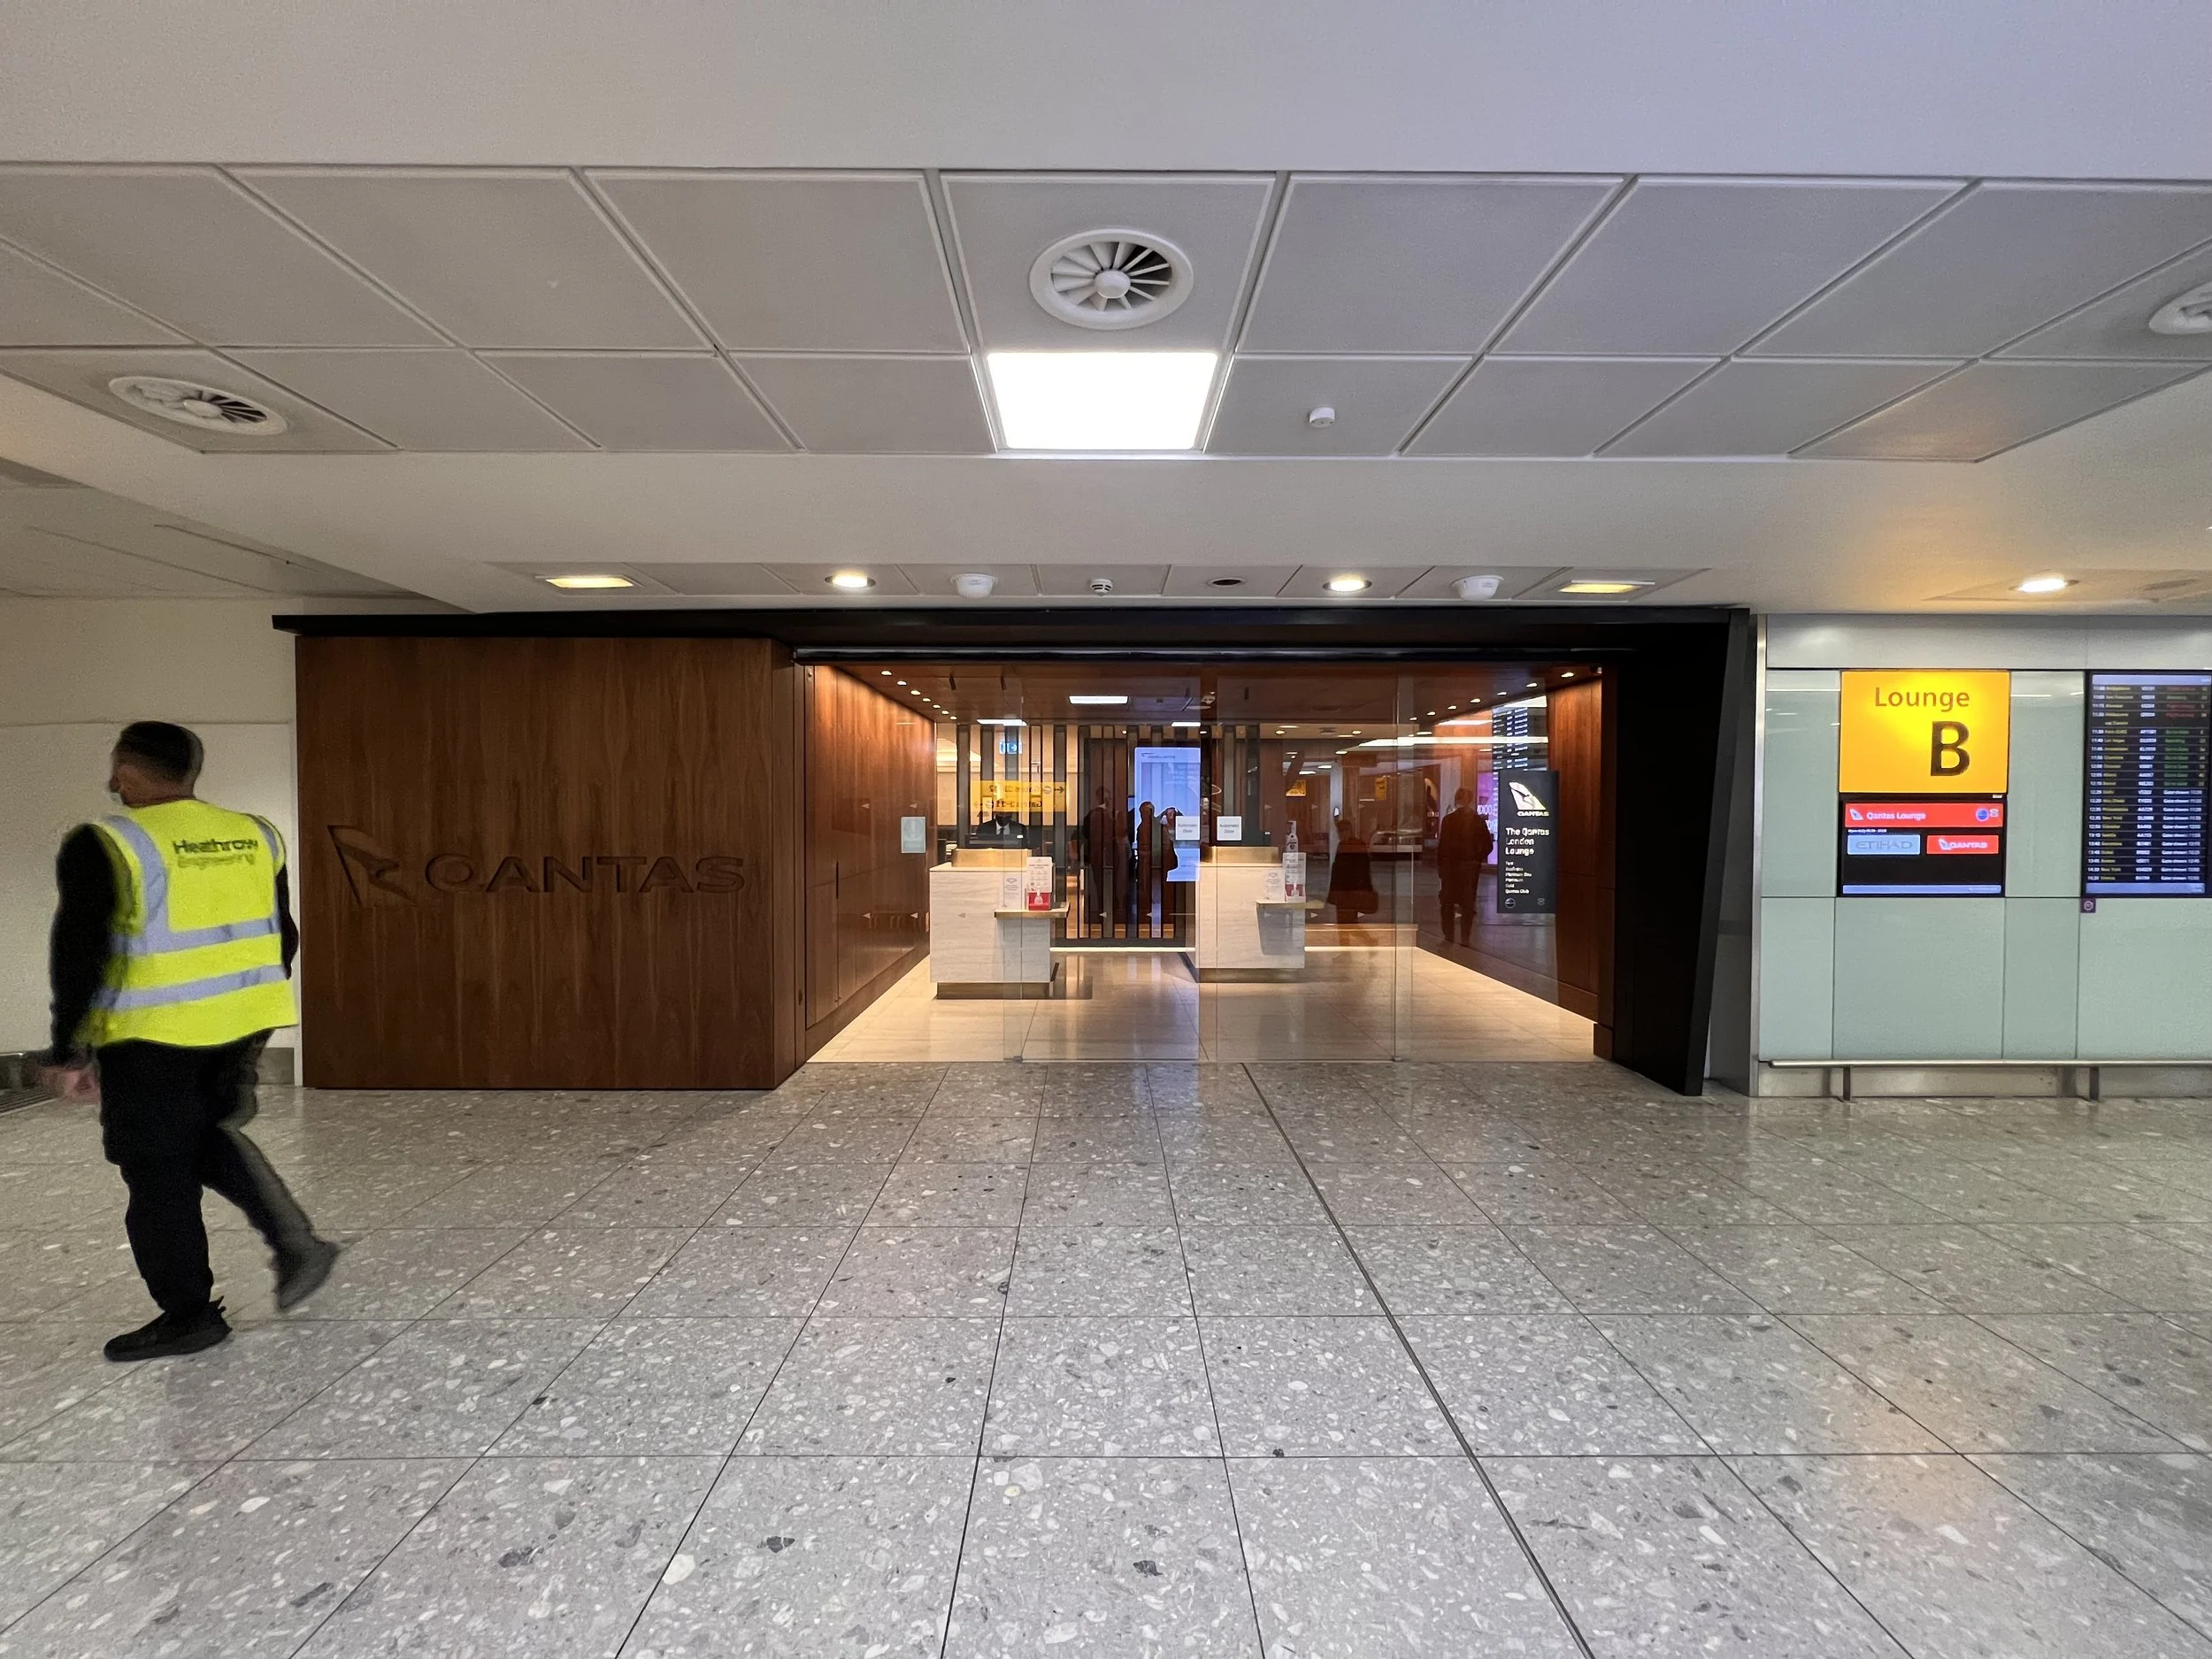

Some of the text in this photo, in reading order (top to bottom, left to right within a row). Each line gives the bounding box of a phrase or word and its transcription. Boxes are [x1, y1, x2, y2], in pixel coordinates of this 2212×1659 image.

[1874, 687, 1970, 712] Lounge
[1930, 720, 1970, 777] B
[1866, 811, 1926, 821] Qantas Lounge
[1505, 827, 1550, 837] The Qantas
[172, 838, 259, 855] Heathrow
[1505, 837, 1535, 846] London
[1855, 841, 1913, 849] ETIHAD
[1505, 847, 1535, 856] Lounge
[424, 853, 746, 895] QANTAS
